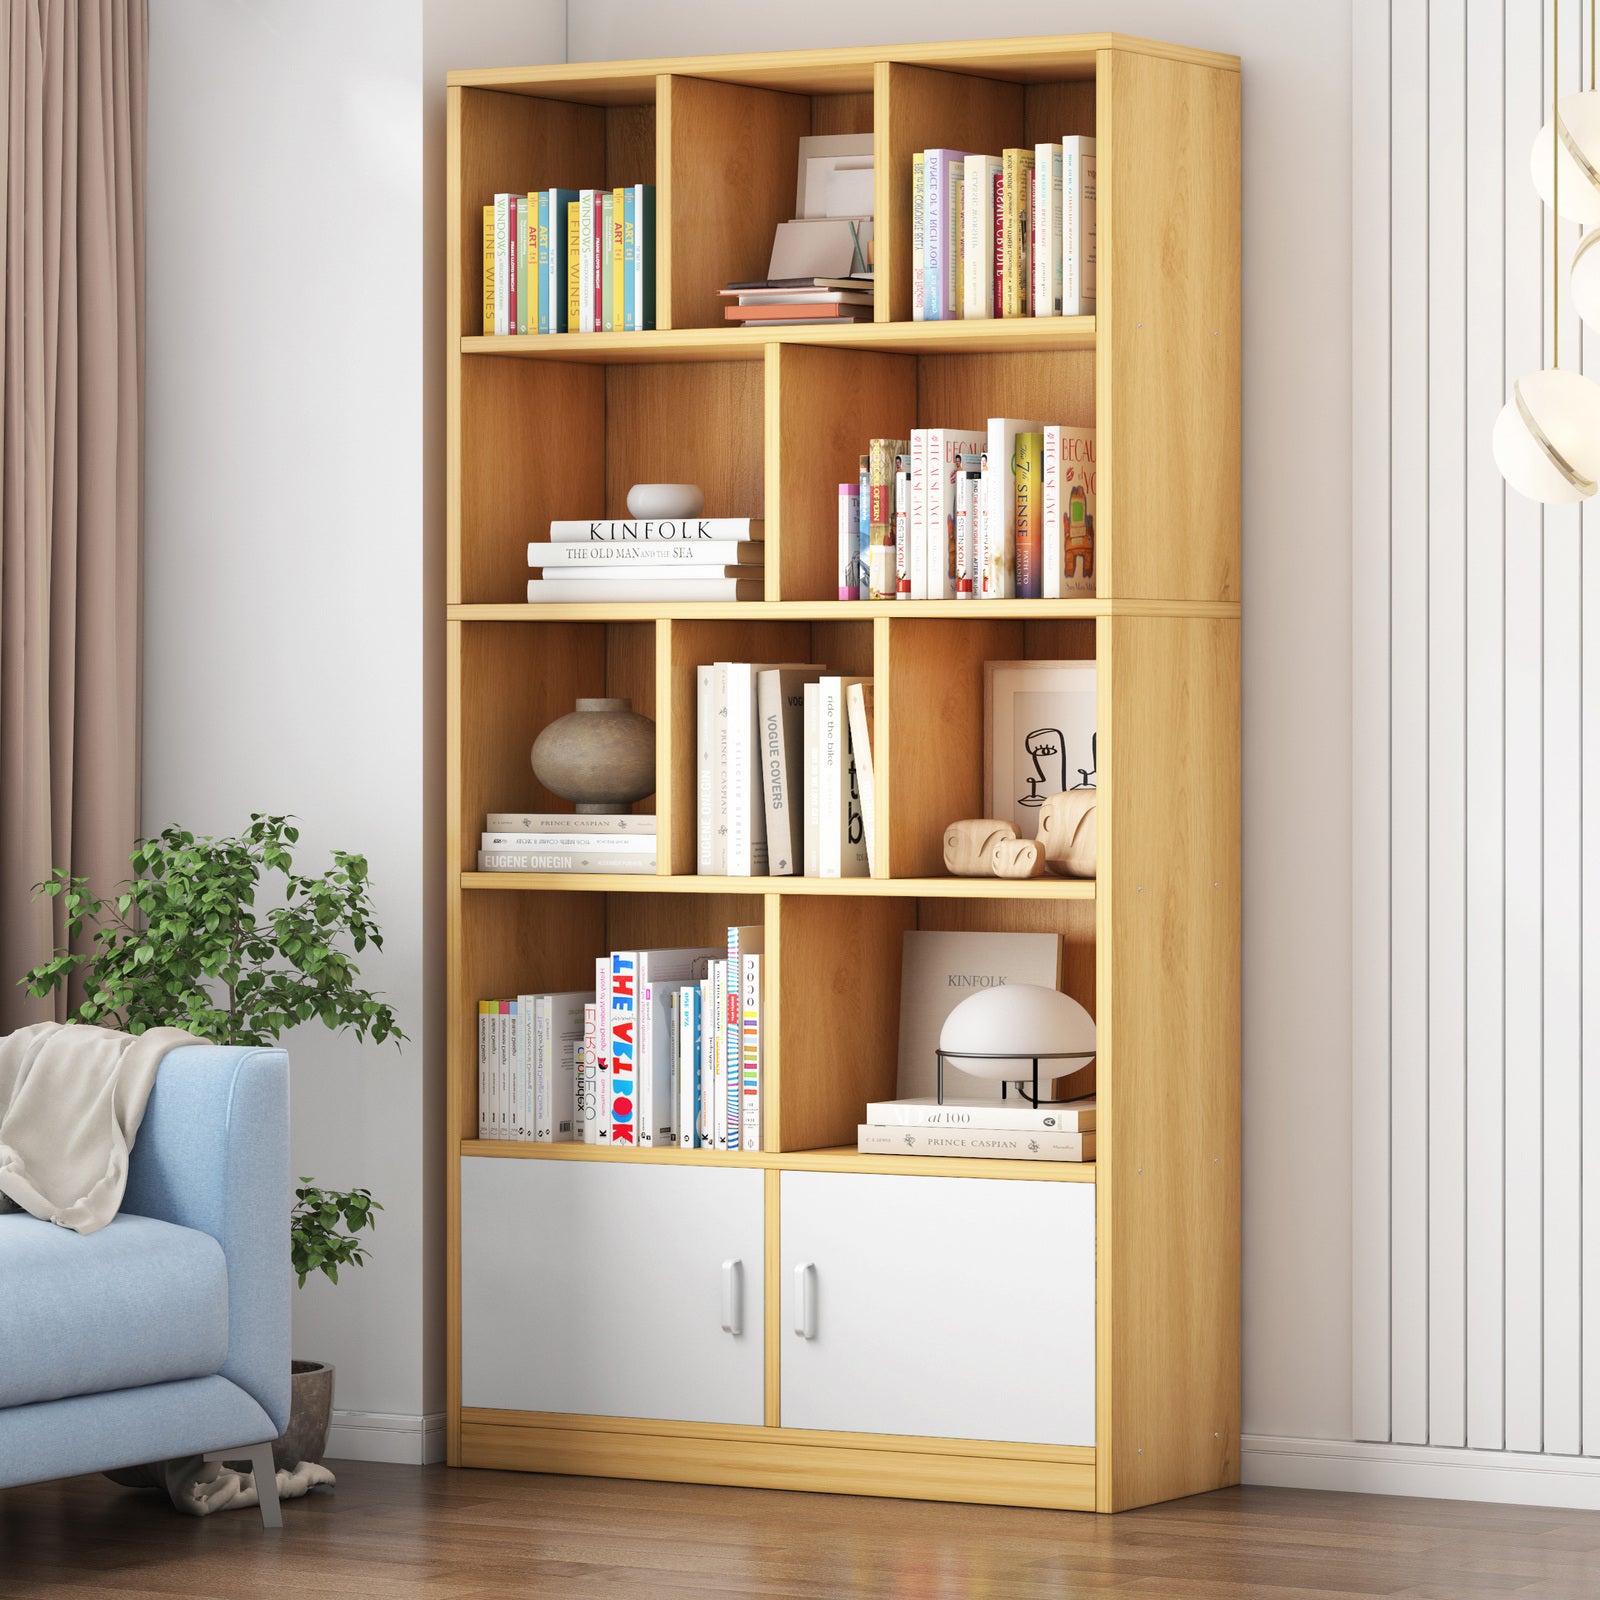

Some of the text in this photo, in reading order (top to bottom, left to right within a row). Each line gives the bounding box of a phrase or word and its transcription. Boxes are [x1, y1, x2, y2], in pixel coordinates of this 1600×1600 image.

[496, 199, 506, 256] WINDOWS
[582, 195, 591, 253] WINDOWS
[614, 222, 622, 245] ART
[626, 222, 634, 244] ART
[485, 224, 494, 319] FINE WINES
[570, 220, 580, 317] FINE WINES
[1016, 462, 1030, 480] 7th
[874, 488, 879, 499] OF
[1017, 484, 1027, 537] SENSE
[590, 520, 713, 540] KINFOLK
[566, 548, 588, 559] THE
[590, 547, 613, 558] OLD
[616, 547, 640, 558] MAN
[656, 550, 670, 558] THE
[672, 547, 694, 558] SEA
[1023, 573, 1029, 584] TO
[827, 696, 835, 766] ride the bike
[767, 714, 783, 810] VOGUE COVERS
[701, 770, 711, 865] EUGENE ONEGIN
[485, 856, 572, 868] EUGENE ONEGIN
[948, 974, 1008, 988] KINFOLK
[927, 1113, 970, 1124] at 100
[927, 1138, 1017, 1149] PRINCE CASPIAN
